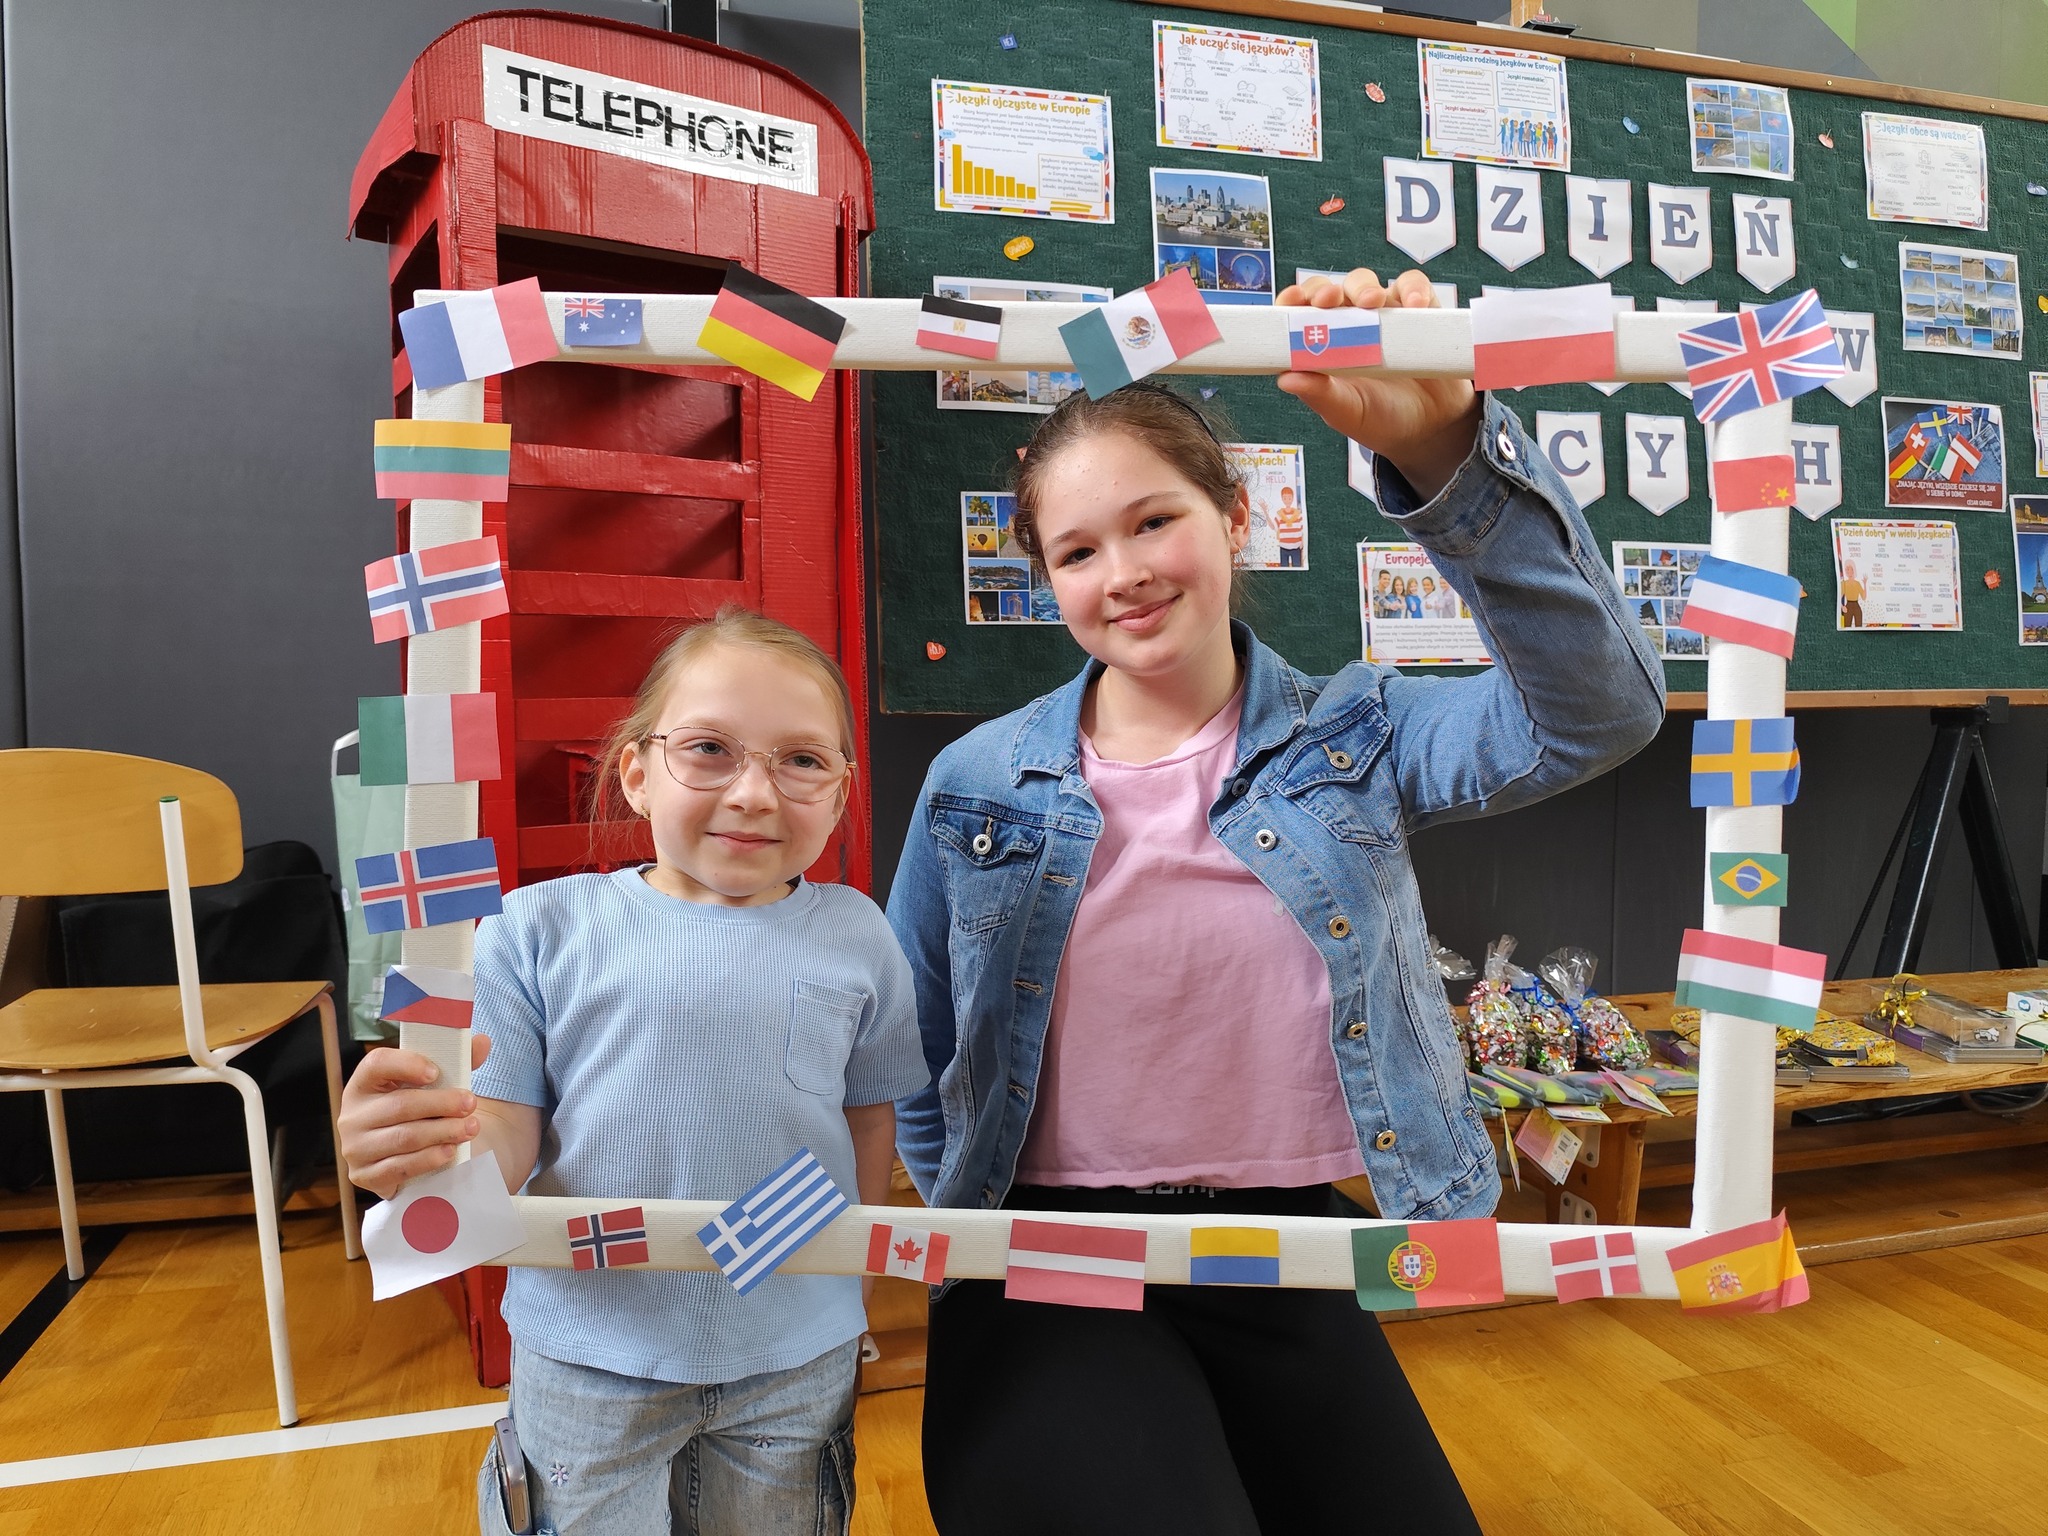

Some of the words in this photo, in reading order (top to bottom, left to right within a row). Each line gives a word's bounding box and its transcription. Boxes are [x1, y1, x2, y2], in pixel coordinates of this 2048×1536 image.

[1179, 34, 1198, 46] Jak
[1200, 38, 1229, 51] uczyć
[1231, 41, 1246, 52] się
[1247, 43, 1295, 57] języków?
[1428, 50, 1474, 63] Najliczniejsze
[1475, 56, 1499, 67] rodziny
[1500, 58, 1526, 69] języków
[1535, 62, 1557, 73] Europie
[956, 93, 990, 107] Języki
[993, 99, 1037, 112] ojczyste
[1051, 103, 1091, 116] Europie
[506, 65, 796, 171] TELEPHONE
[1882, 123, 1908, 136] Języki
[1910, 126, 1929, 136] obce
[1930, 130, 1939, 139] są
[1940, 131, 1967, 141] ważne
[1395, 176, 1780, 257] DZIEŃ
[1239, 455, 1287, 468] ęzykach!
[1265, 475, 1287, 484] HELLO
[1898, 529, 1917, 537] wielu
[1917, 530, 1951, 540] językach!
